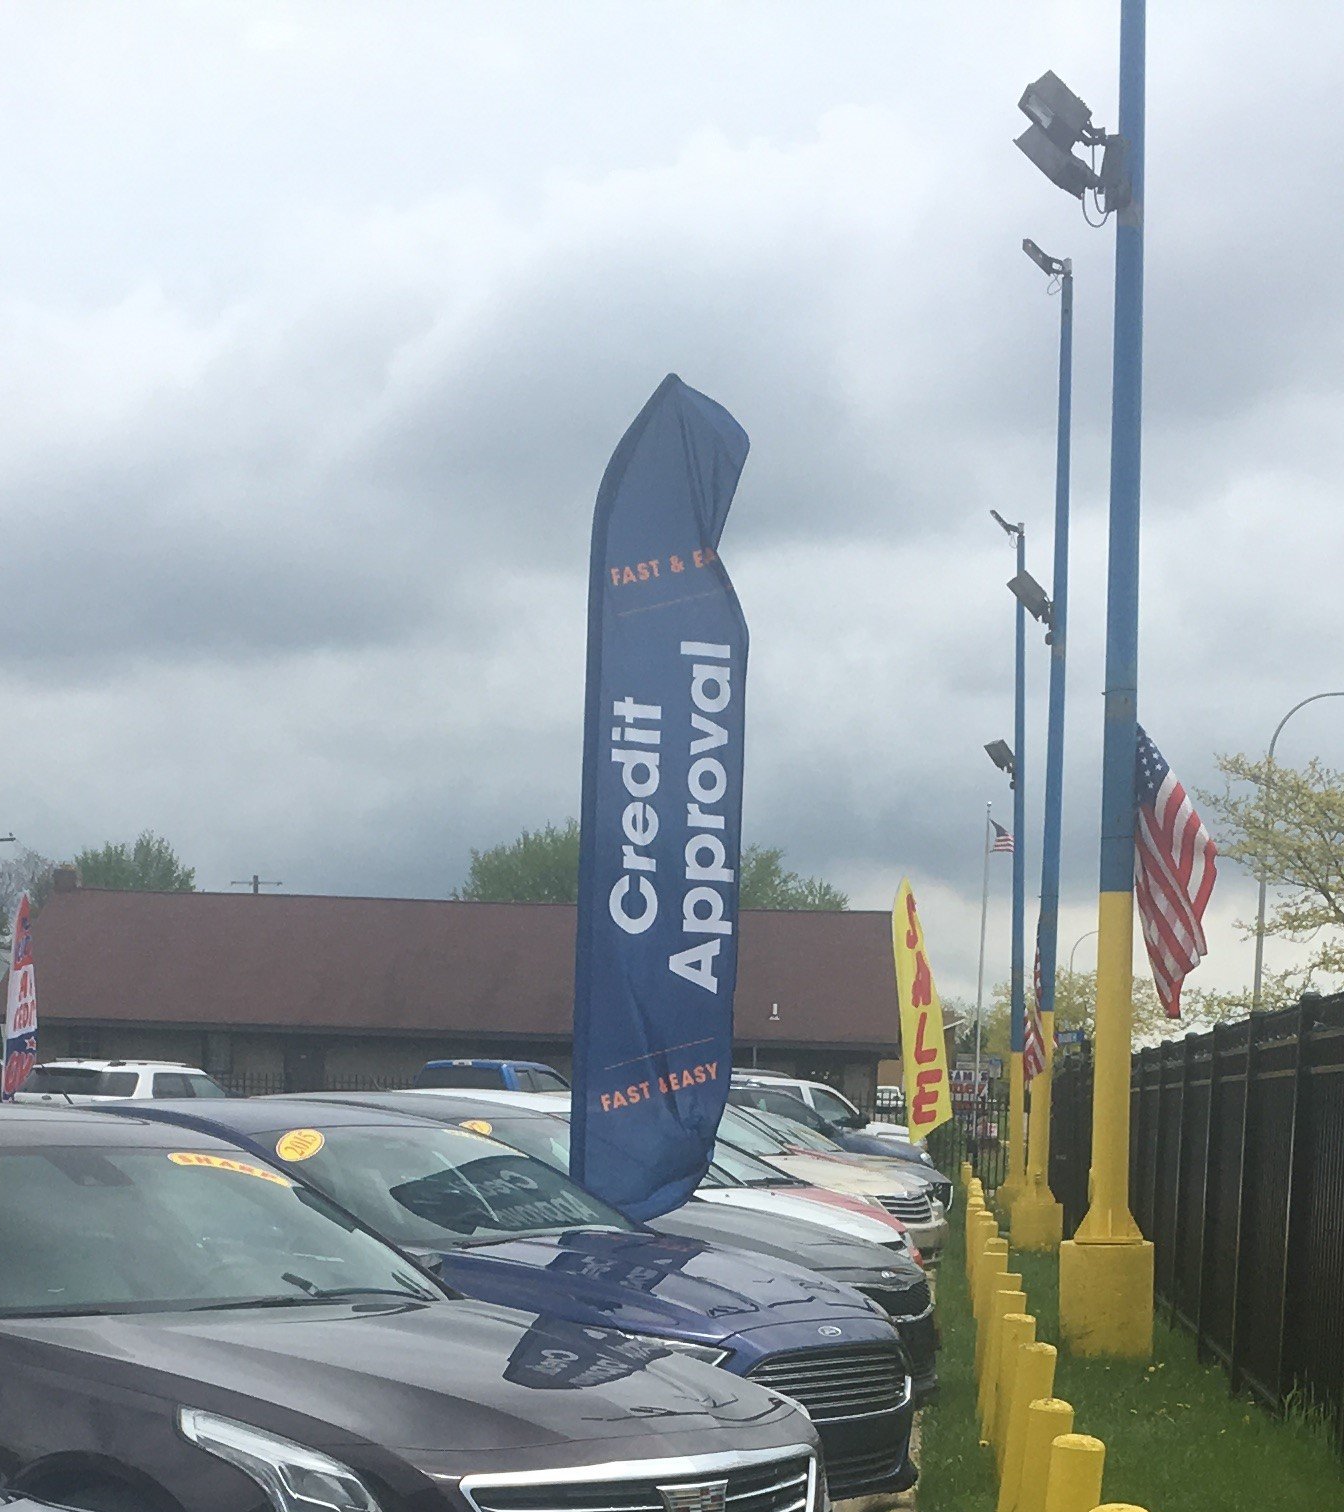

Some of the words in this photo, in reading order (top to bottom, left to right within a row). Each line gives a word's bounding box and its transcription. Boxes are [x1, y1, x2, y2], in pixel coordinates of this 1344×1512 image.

[610, 559, 660, 586] FAST
[669, 555, 684, 573] &
[609, 697, 662, 934] Credit
[669, 641, 735, 994] Approval
[600, 1082, 650, 1112] FAST
[668, 1062, 718, 1091] EASY
[905, 893, 943, 1126] SALE
